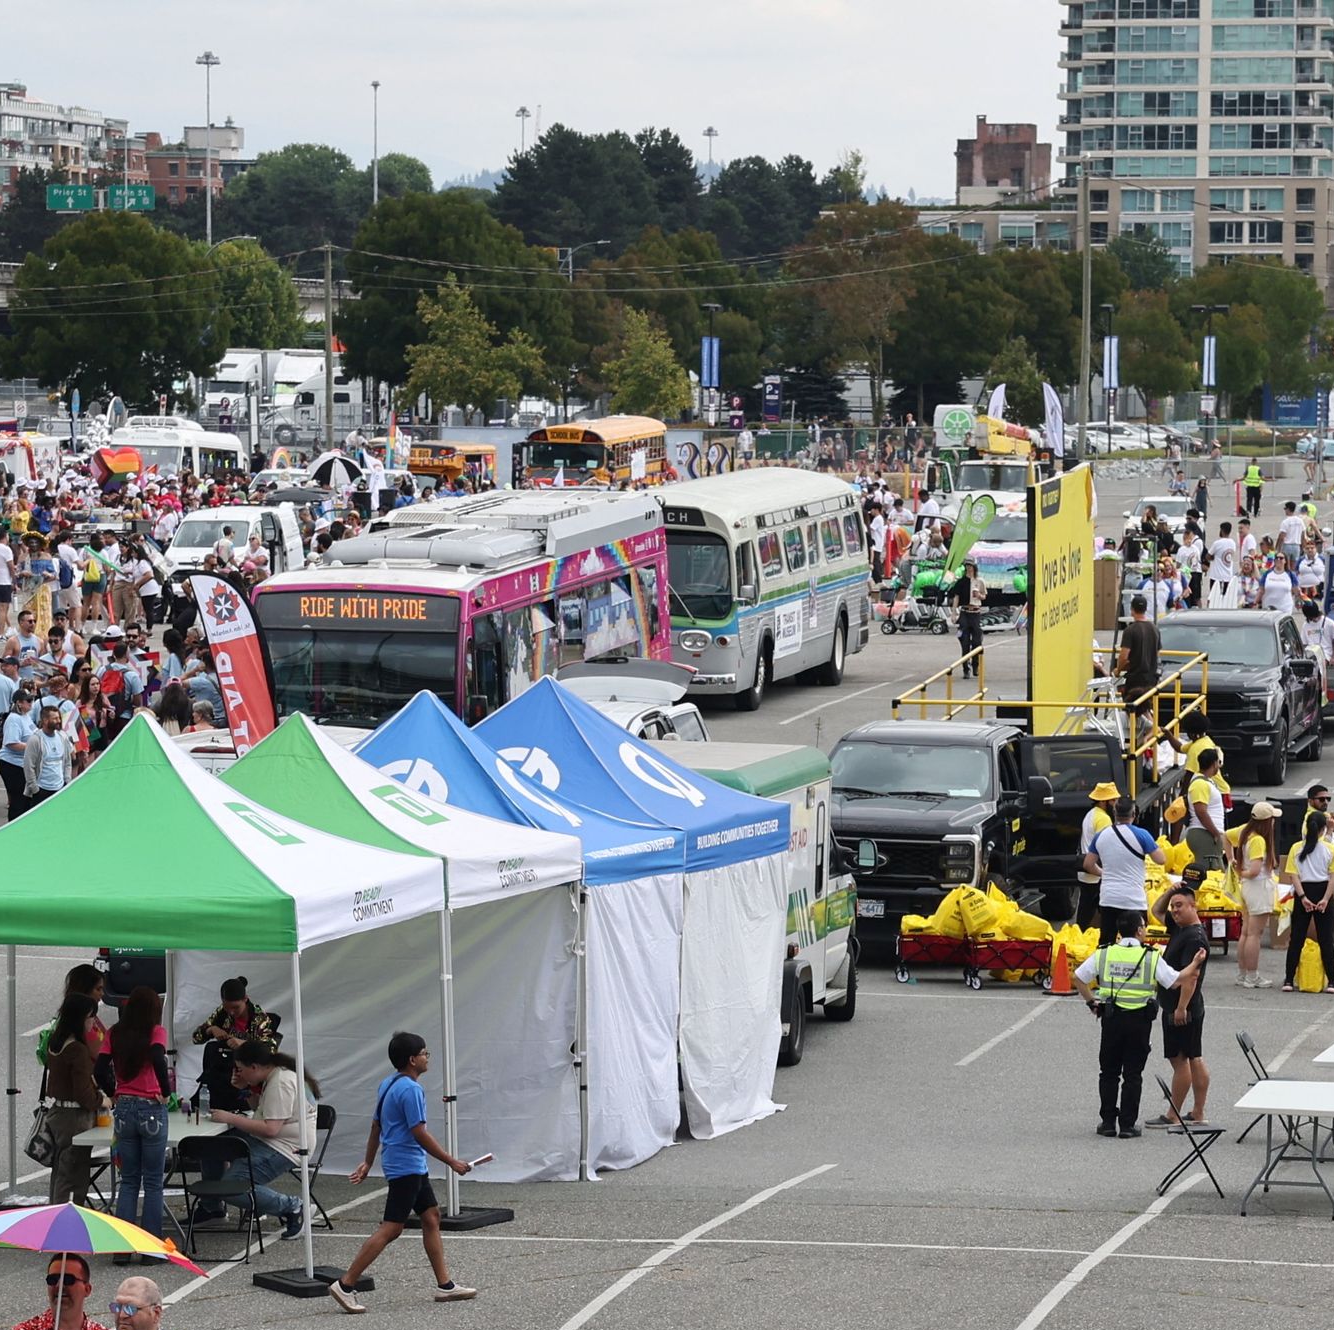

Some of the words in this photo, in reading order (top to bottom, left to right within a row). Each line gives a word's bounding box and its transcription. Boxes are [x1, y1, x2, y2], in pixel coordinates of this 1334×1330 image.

[53, 189, 76, 198] Prior
[77, 189, 87, 197] St
[138, 189, 147, 197] St
[550, 431, 569, 440] SCHOOL
[570, 431, 580, 440] BUS
[1041, 553, 1058, 594] love
[1060, 545, 1066, 585] is
[1068, 542, 1082, 581] love
[300, 597, 334, 618] RIDE
[340, 597, 377, 619] WITH
[383, 598, 427, 620] PRIDE
[1041, 609, 1048, 633] no
[1048, 599, 1060, 628] label
[1060, 593, 1080, 625] required
[697, 831, 721, 850] BUILDING
[721, 825, 753, 845] COMMUNITIES
[754, 819, 778, 839] TOGETHER
[498, 858, 506, 873] TD
[499, 869, 539, 888] COMMITMENT
[353, 892, 362, 906] TD
[361, 886, 383, 903] READY
[352, 898, 394, 922] COMMITMENT
